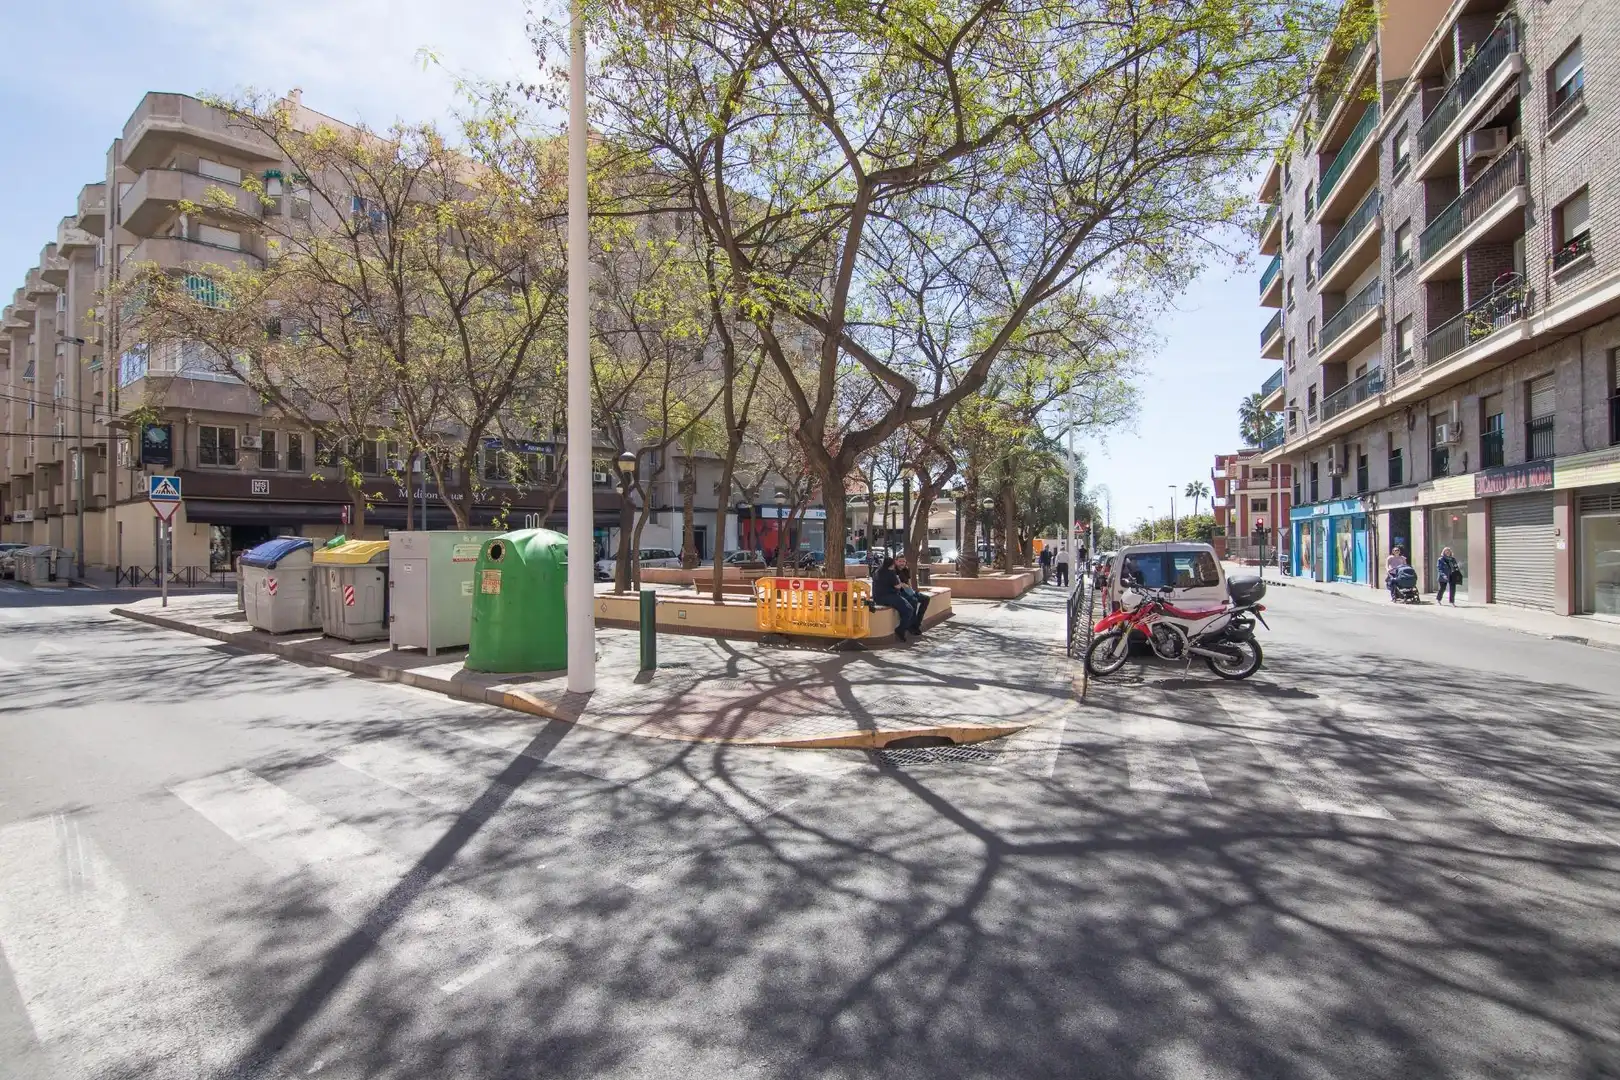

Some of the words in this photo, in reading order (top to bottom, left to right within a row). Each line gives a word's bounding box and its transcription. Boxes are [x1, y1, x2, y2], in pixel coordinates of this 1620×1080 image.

[1517, 469, 1527, 489] LA
[1528, 465, 1553, 488] MODA
[398, 488, 439, 500] Mdion
